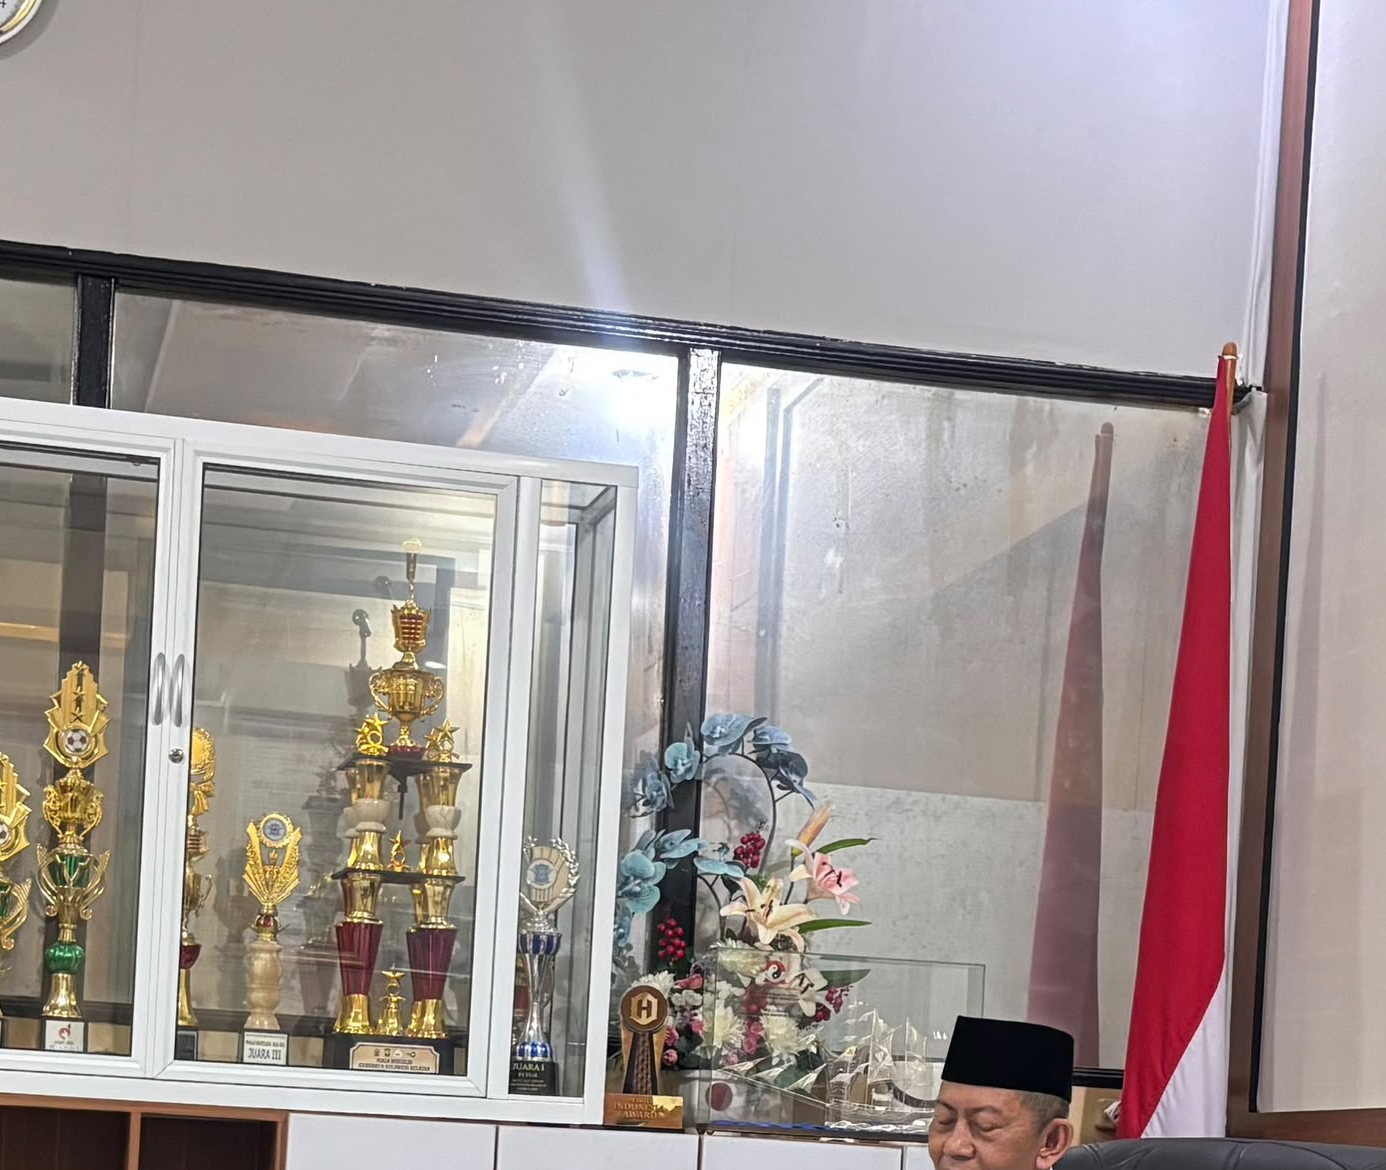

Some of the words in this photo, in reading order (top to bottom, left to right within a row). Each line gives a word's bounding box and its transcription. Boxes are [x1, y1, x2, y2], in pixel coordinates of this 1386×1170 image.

[248, 1048, 271, 1060] JUARA
[272, 1049, 282, 1060] III
[512, 1063, 540, 1072] JUARA
